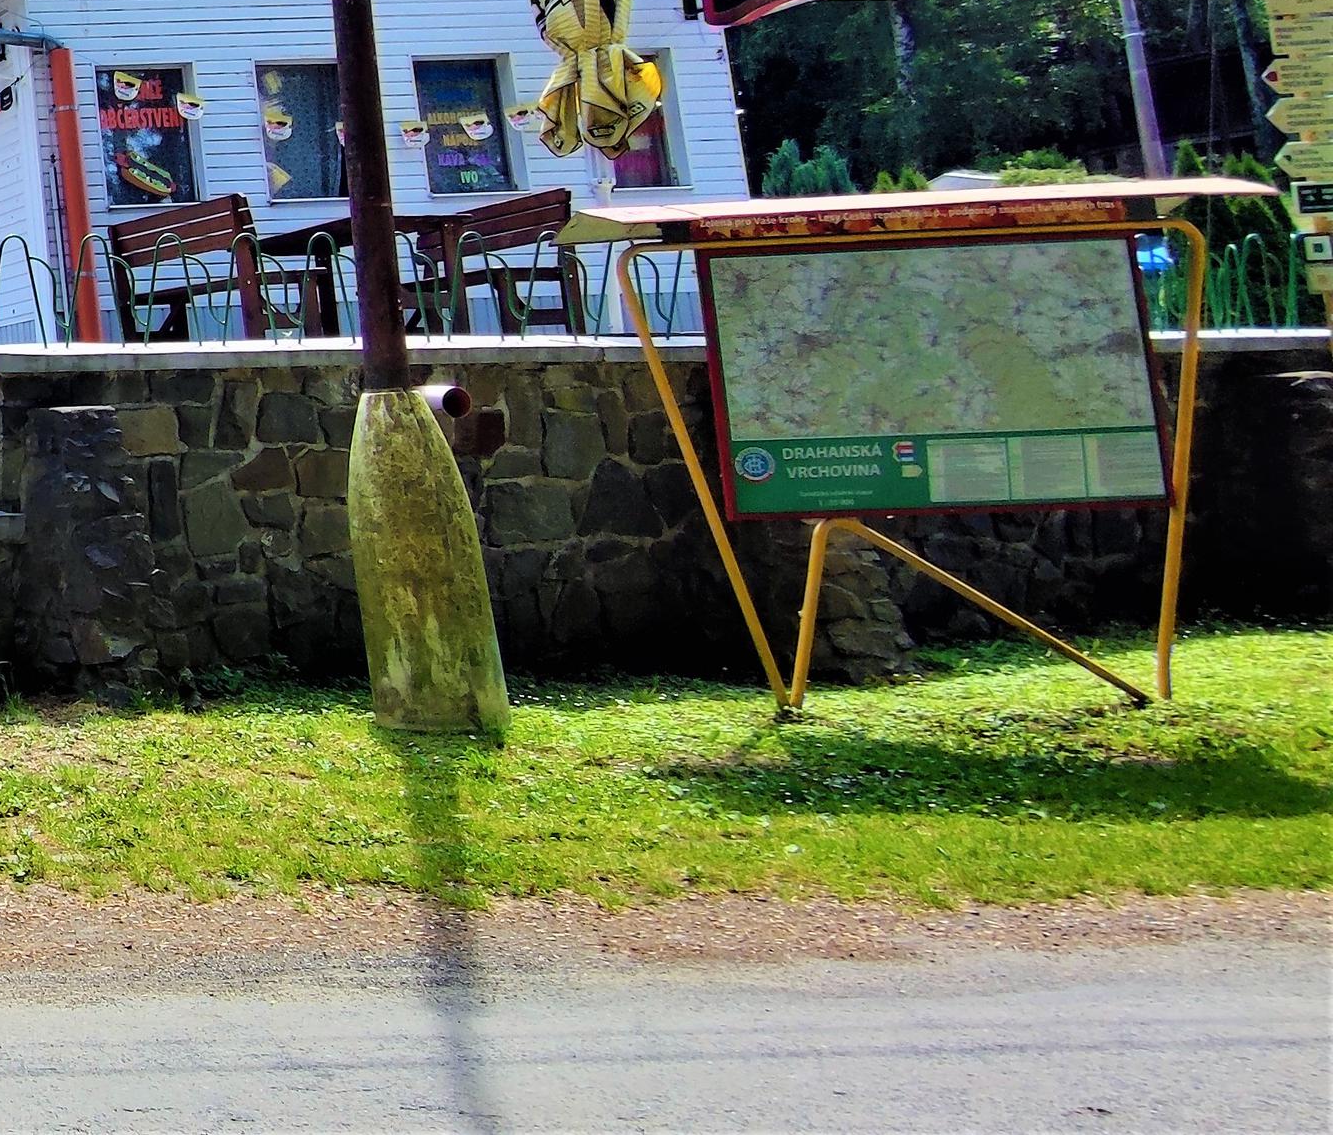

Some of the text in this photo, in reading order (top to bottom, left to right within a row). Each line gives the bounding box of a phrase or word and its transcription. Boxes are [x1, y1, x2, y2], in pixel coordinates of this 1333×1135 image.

[100, 102, 182, 130] OBČERSTVEN
[782, 441, 883, 460] DRAHANSKÁ
[785, 464, 881, 479] VRCHOVINA
